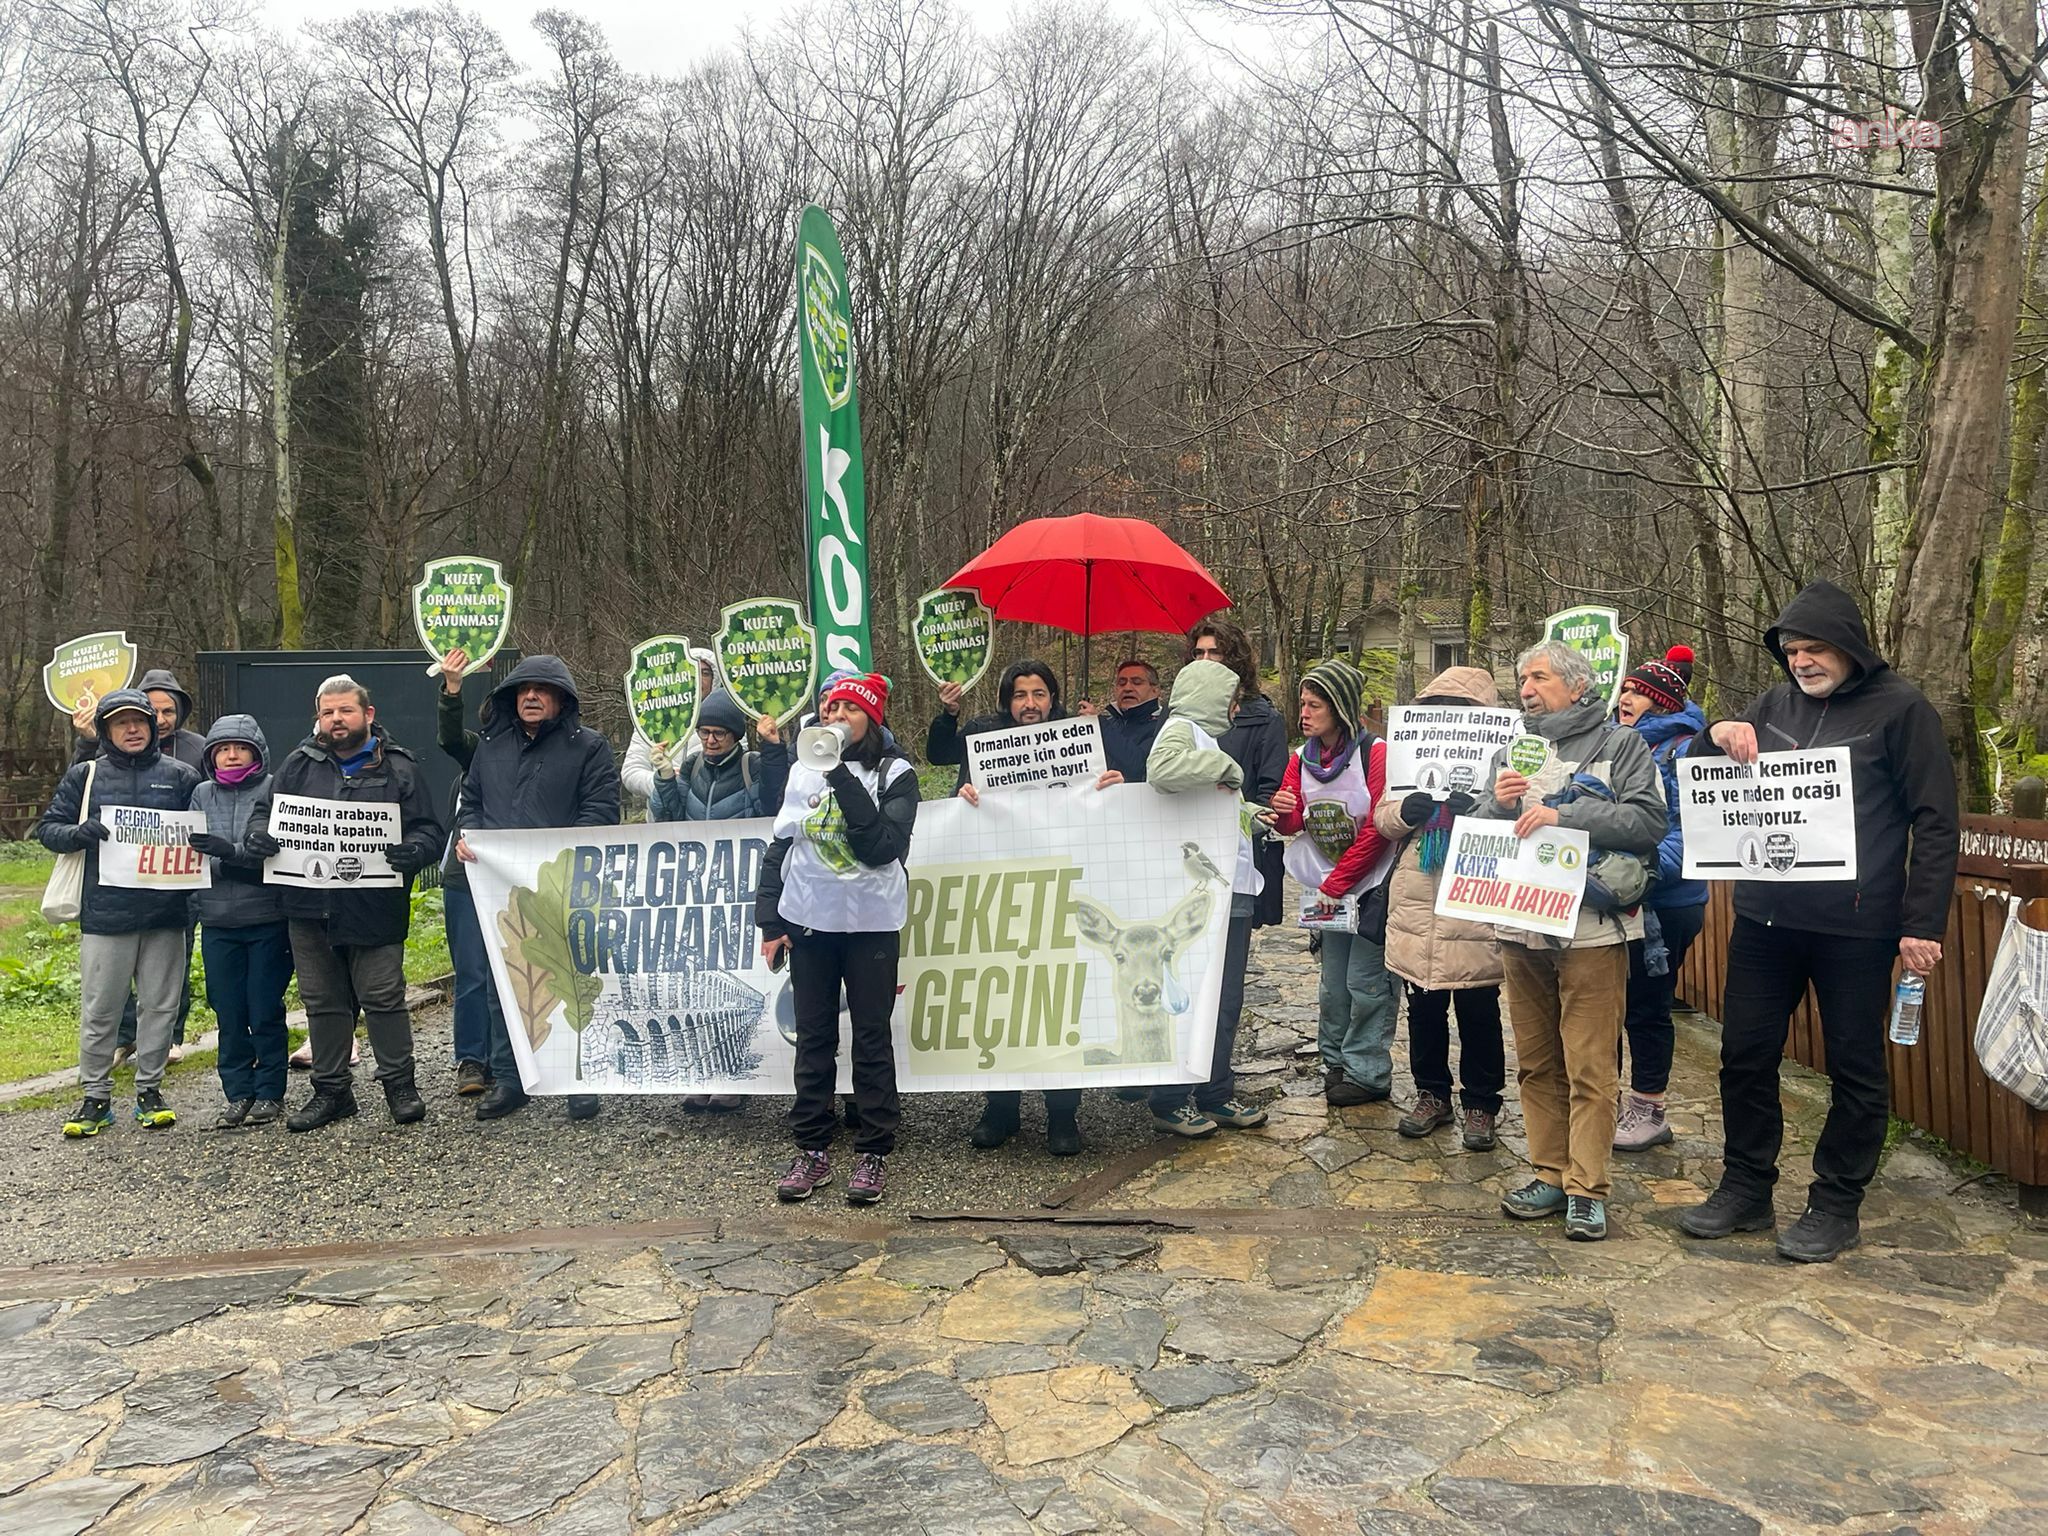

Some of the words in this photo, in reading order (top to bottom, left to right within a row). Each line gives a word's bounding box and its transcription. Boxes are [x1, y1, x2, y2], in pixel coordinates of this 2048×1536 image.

[444, 573, 483, 586] KUZEY
[426, 594, 500, 606] ORMANLARI
[934, 600, 966, 615] KUZEY
[427, 615, 499, 627] SAVUNMASI
[743, 615, 783, 631] KUZEY
[922, 616, 984, 636] ORMANLARI
[1562, 624, 1600, 640] KUZEY
[73, 643, 105, 657] KUZEY
[727, 637, 805, 656] ORMANLARI
[925, 635, 985, 655] SAVUNMASI
[59, 648, 119, 669] ORMANLARI
[59, 657, 119, 678] SAVUNMASI
[646, 651, 677, 668] KUZEY
[731, 659, 807, 678] SAVUNMASI
[634, 671, 691, 691] ORMANLARI
[637, 691, 693, 713] SAVUNMASI
[1403, 710, 1464, 724] Ormanları
[1468, 711, 1511, 727] talana
[973, 734, 1031, 753] Ormanları
[1034, 728, 1058, 745] yok
[1062, 723, 1095, 739] eden
[1393, 730, 1418, 742] açan
[1421, 727, 1520, 745] yönetmelikler
[979, 753, 1030, 771] sermaye
[1033, 748, 1056, 763] için
[1060, 742, 1093, 758] odun
[1415, 745, 1440, 759] geri
[1444, 746, 1484, 760] çekin!
[986, 769, 1048, 788] üretimine
[1051, 759, 1089, 778] hayır!
[1759, 758, 1837, 778] kemiren
[1691, 788, 1716, 806] taş
[1721, 789, 1739, 803] ve
[1792, 780, 1841, 800] ocağı
[115, 808, 160, 829] BELGRAD
[278, 801, 331, 819] Ormanları
[336, 808, 393, 822] arabaya,
[1723, 809, 1808, 827] istemiyoruz.
[116, 826, 160, 846] ORMANI
[278, 821, 329, 835] mangala
[333, 824, 387, 838] kapatın,
[276, 838, 335, 852] angından
[1458, 832, 1520, 860] ORMANI
[138, 845, 157, 875] EL
[162, 846, 204, 875] ELE!
[1454, 853, 1499, 880] KAYIR,
[569, 838, 768, 908] BELGRAD
[1448, 876, 1511, 908] BETONA
[1510, 885, 1577, 920] HAYIR!
[899, 867, 1083, 958] REKETE
[911, 945, 1088, 1070] GEÇİN!
